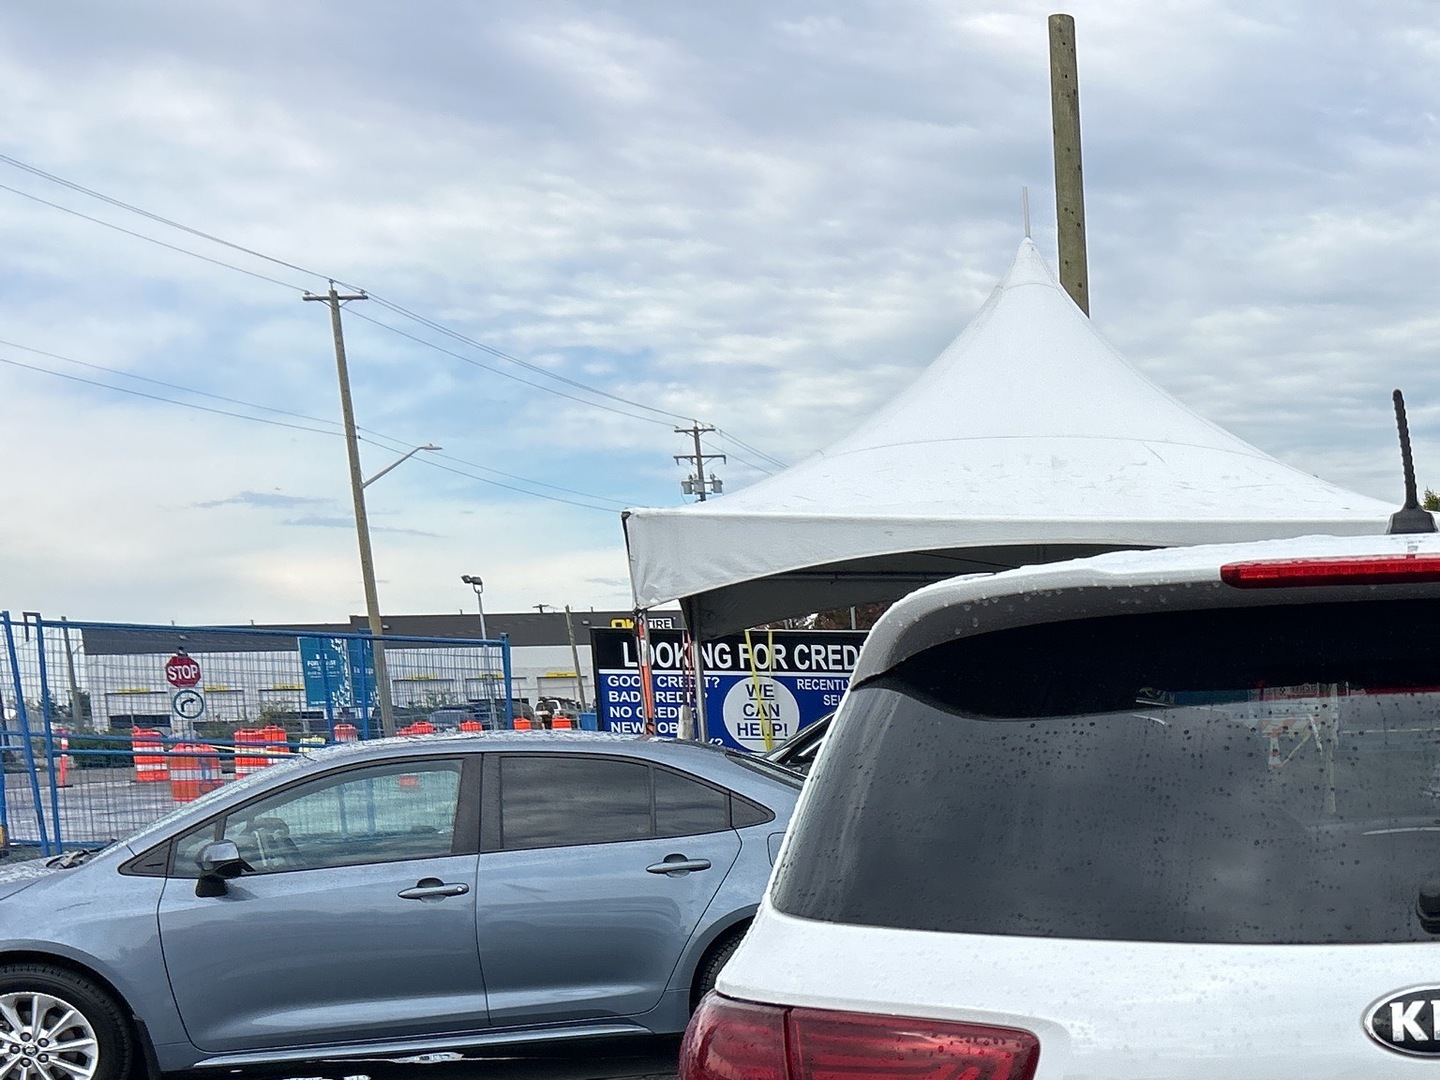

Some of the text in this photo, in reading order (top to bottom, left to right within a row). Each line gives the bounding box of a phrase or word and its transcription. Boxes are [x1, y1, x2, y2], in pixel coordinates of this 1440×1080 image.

[622, 641, 862, 671] LOKNG FOR CRED
[167, 664, 198, 681] STOP
[607, 675, 720, 688] GOO CRET?
[608, 691, 641, 703] BAD
[745, 683, 775, 698] WE
[610, 706, 632, 718] NO
[743, 703, 780, 717] CAN
[610, 721, 645, 734] NEW
